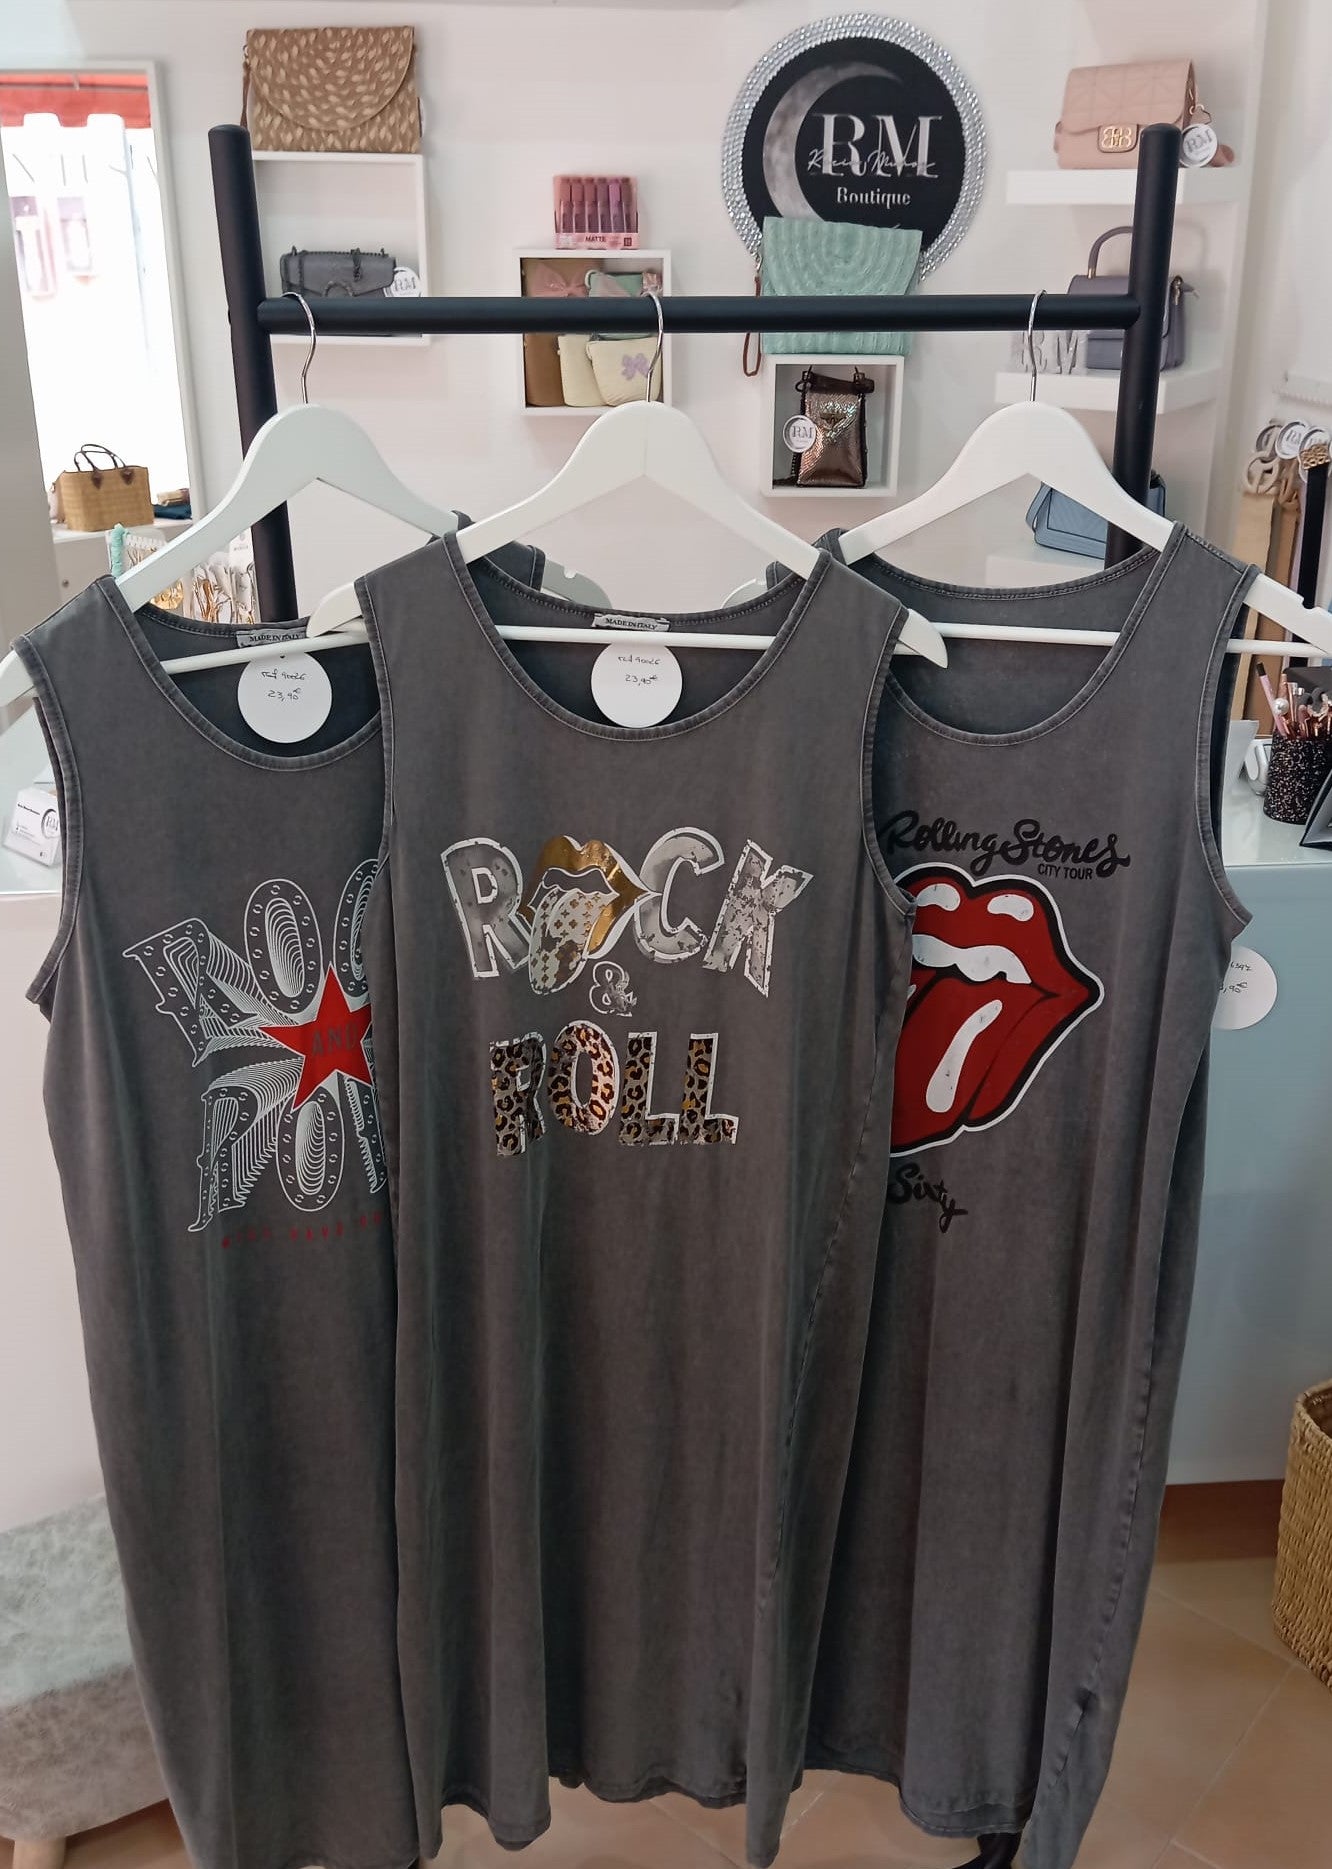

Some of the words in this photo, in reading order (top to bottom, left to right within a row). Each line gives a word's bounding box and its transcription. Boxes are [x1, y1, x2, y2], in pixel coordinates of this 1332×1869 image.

[810, 113, 943, 178] RM
[836, 186, 912, 210] Boutique
[791, 425, 815, 439] RM
[249, 634, 272, 642] MADE
[606, 617, 628, 627] MADE
[637, 622, 658, 631] ITALY
[878, 809, 1000, 877] Rolling
[999, 818, 1132, 879] Stones
[1037, 863, 1059, 878] CITY
[1063, 865, 1093, 881] TOUR
[589, 960, 638, 1017] &
[311, 1021, 360, 1057] AND
[488, 1019, 740, 1157] ROLL
[887, 1162, 970, 1234] Sixty
